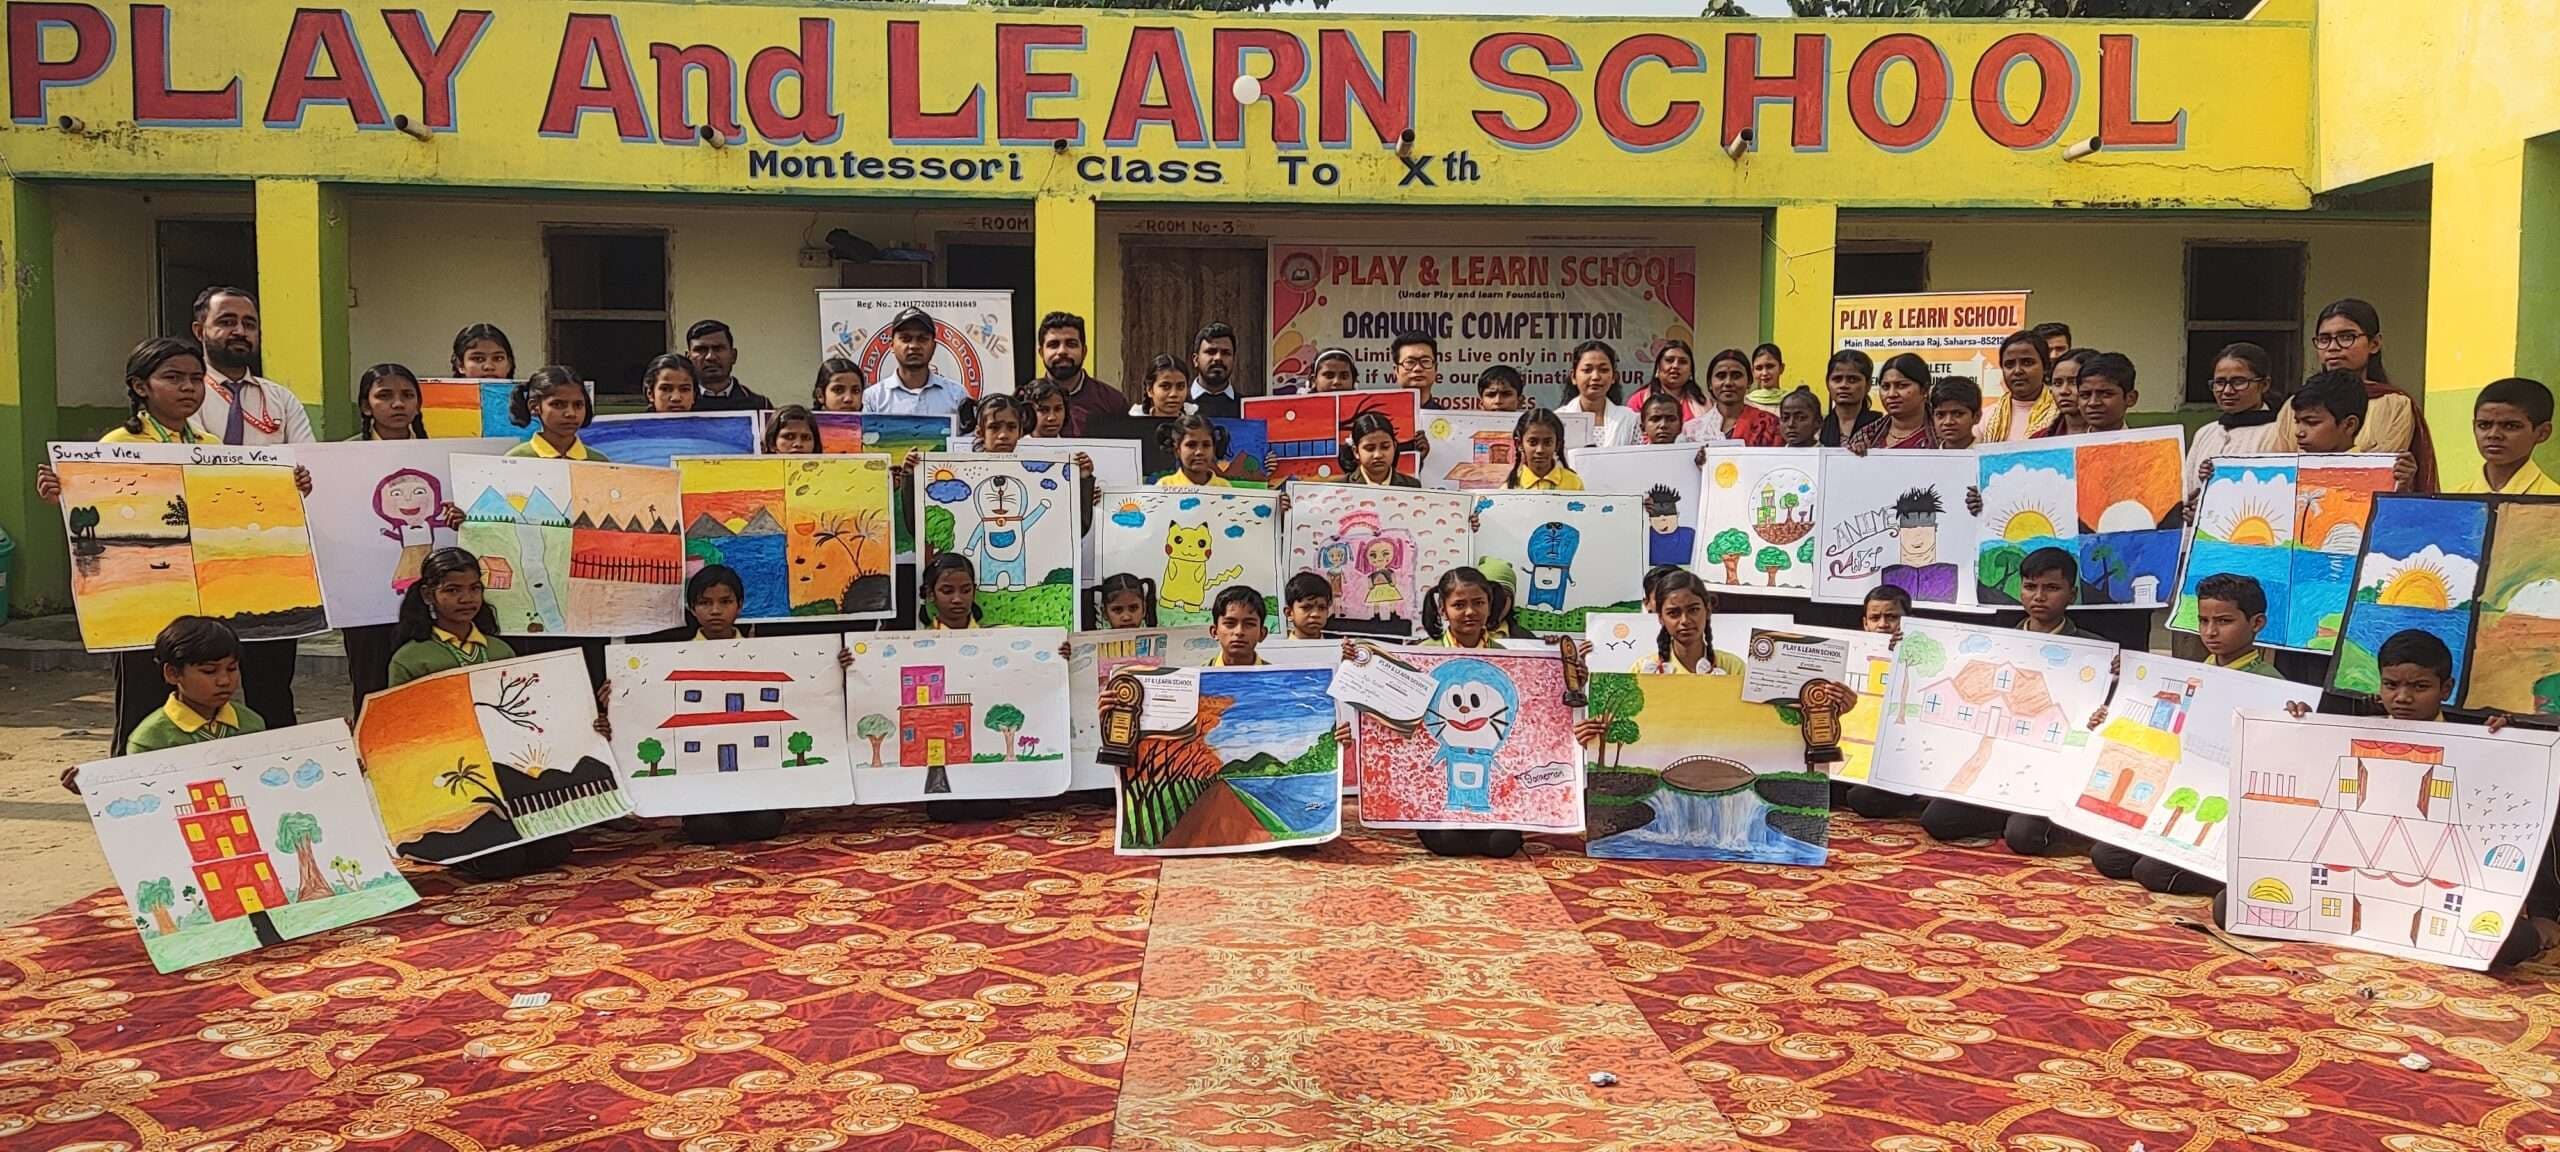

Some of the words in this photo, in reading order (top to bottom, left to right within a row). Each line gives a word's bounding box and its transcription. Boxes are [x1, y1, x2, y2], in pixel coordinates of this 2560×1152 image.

[5, 2, 494, 132] PLAY
[538, 12, 844, 146] And
[887, 19, 1418, 150] LEARN
[1469, 31, 2187, 153] SCHOOL
[749, 148, 1025, 184] Montessori
[1075, 153, 1224, 185] Class
[1277, 153, 1340, 188] To
[981, 216, 1030, 231] ROOM
[1145, 219, 1187, 233] ROOM
[1331, 254, 1409, 287] PLAY
[1417, 254, 1441, 287] &
[1450, 254, 1550, 288] LEARN
[1560, 254, 1682, 289] SCHOOL
[1397, 290, 1431, 300] (Under
[1433, 290, 1455, 301] Play
[1457, 290, 1476, 300] and
[1505, 290, 1566, 301] Foundation)
[1342, 311, 1454, 339] DRAWING
[1461, 311, 1623, 340] COMPETITION
[1839, 309, 1878, 331] PLAY
[1882, 309, 1894, 330] &
[1899, 306, 1949, 330] LEARN
[1953, 304, 2018, 329] SCHOOL
[1844, 339, 1863, 348] Main
[943, 328, 980, 389] School
[1458, 347, 1492, 363] Live
[1497, 347, 1536, 366] only
[1540, 347, 1557, 363] in
[1365, 368, 1378, 384] if
[1449, 373, 1478, 384] our
[52, 445, 102, 461] Sunset
[111, 446, 142, 460] View
[190, 446, 245, 465] Sunrise
[249, 449, 279, 462] View
[1802, 645, 1820, 655] LEARN
